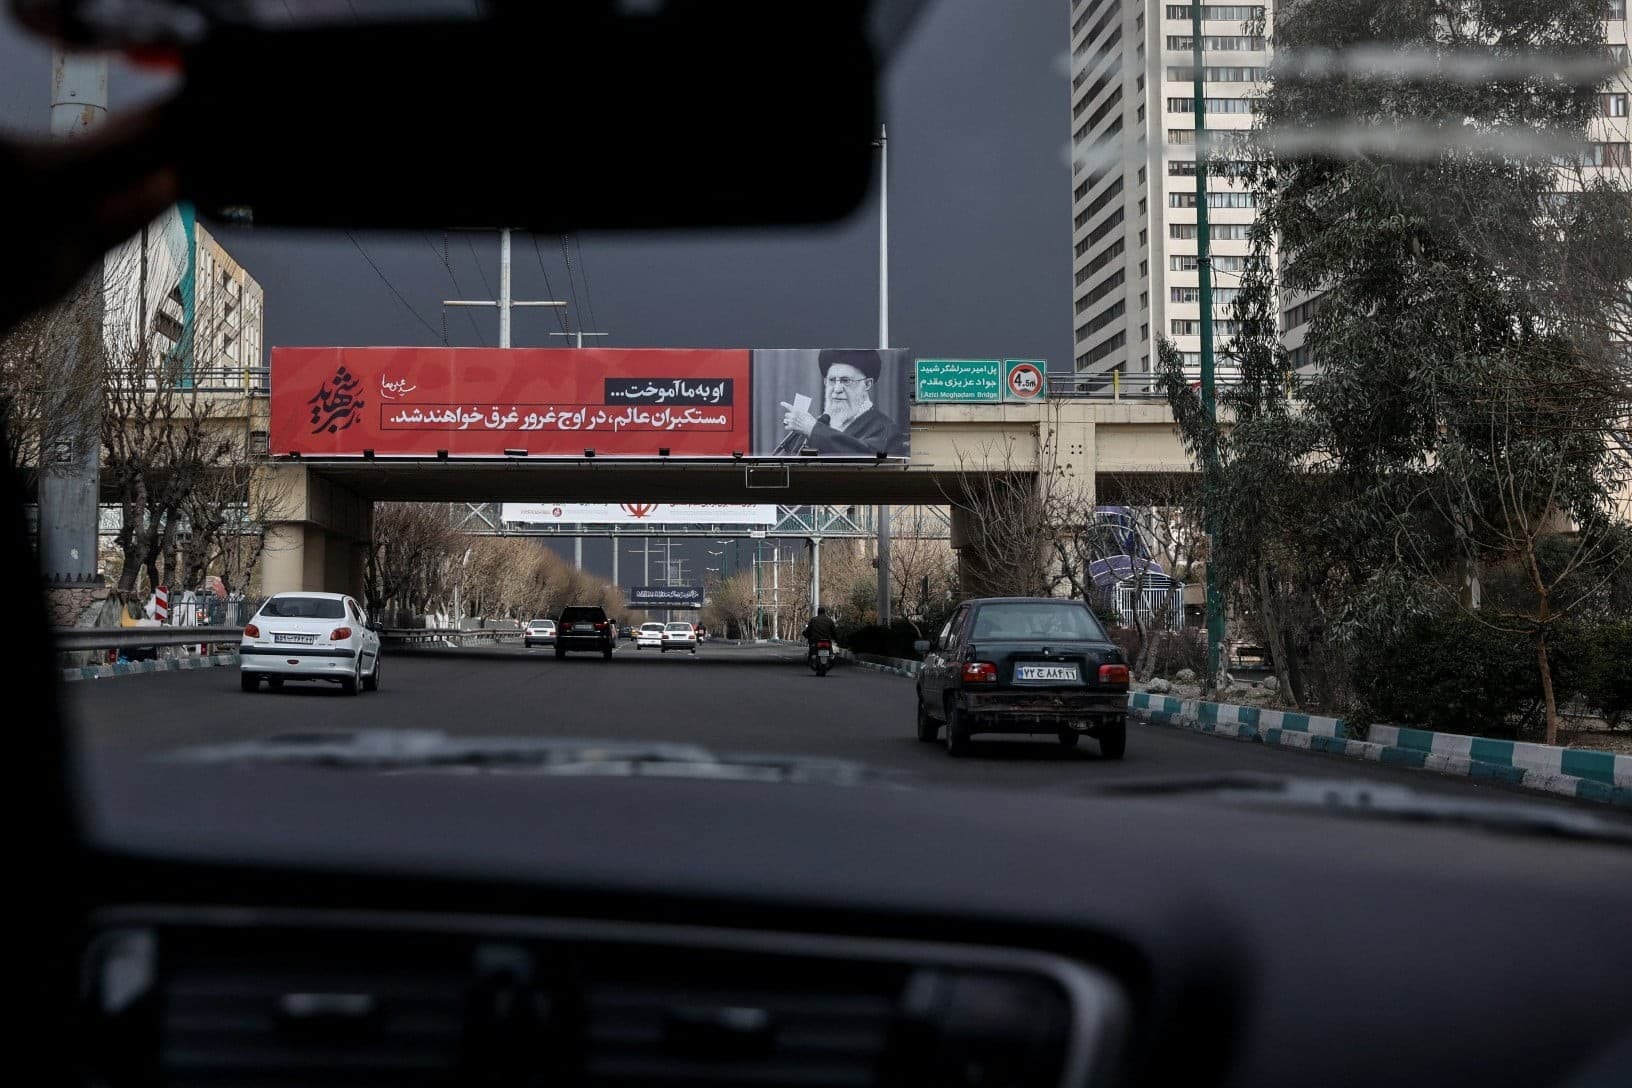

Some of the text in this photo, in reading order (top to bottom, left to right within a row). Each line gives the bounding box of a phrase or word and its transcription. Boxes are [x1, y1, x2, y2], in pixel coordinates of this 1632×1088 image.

[920, 364, 940, 375] شهید
[970, 365, 986, 374] امیر
[986, 365, 998, 376] پل
[681, 381, 695, 398] ما
[920, 377, 997, 389] جواد عزیزی مقدم
[1014, 373, 1036, 388] 4.5m
[695, 383, 710, 402] به
[710, 382, 725, 403] او
[940, 391, 975, 399] Moghadam
[977, 391, 998, 399] Bridge
[423, 406, 484, 430] خواهند
[484, 406, 519, 430] غرق
[519, 406, 557, 430] غرور
[558, 407, 586, 430] اوج
[585, 409, 607, 430] در
[608, 407, 651, 432] عالم،
[652, 407, 727, 430] مستکبران
